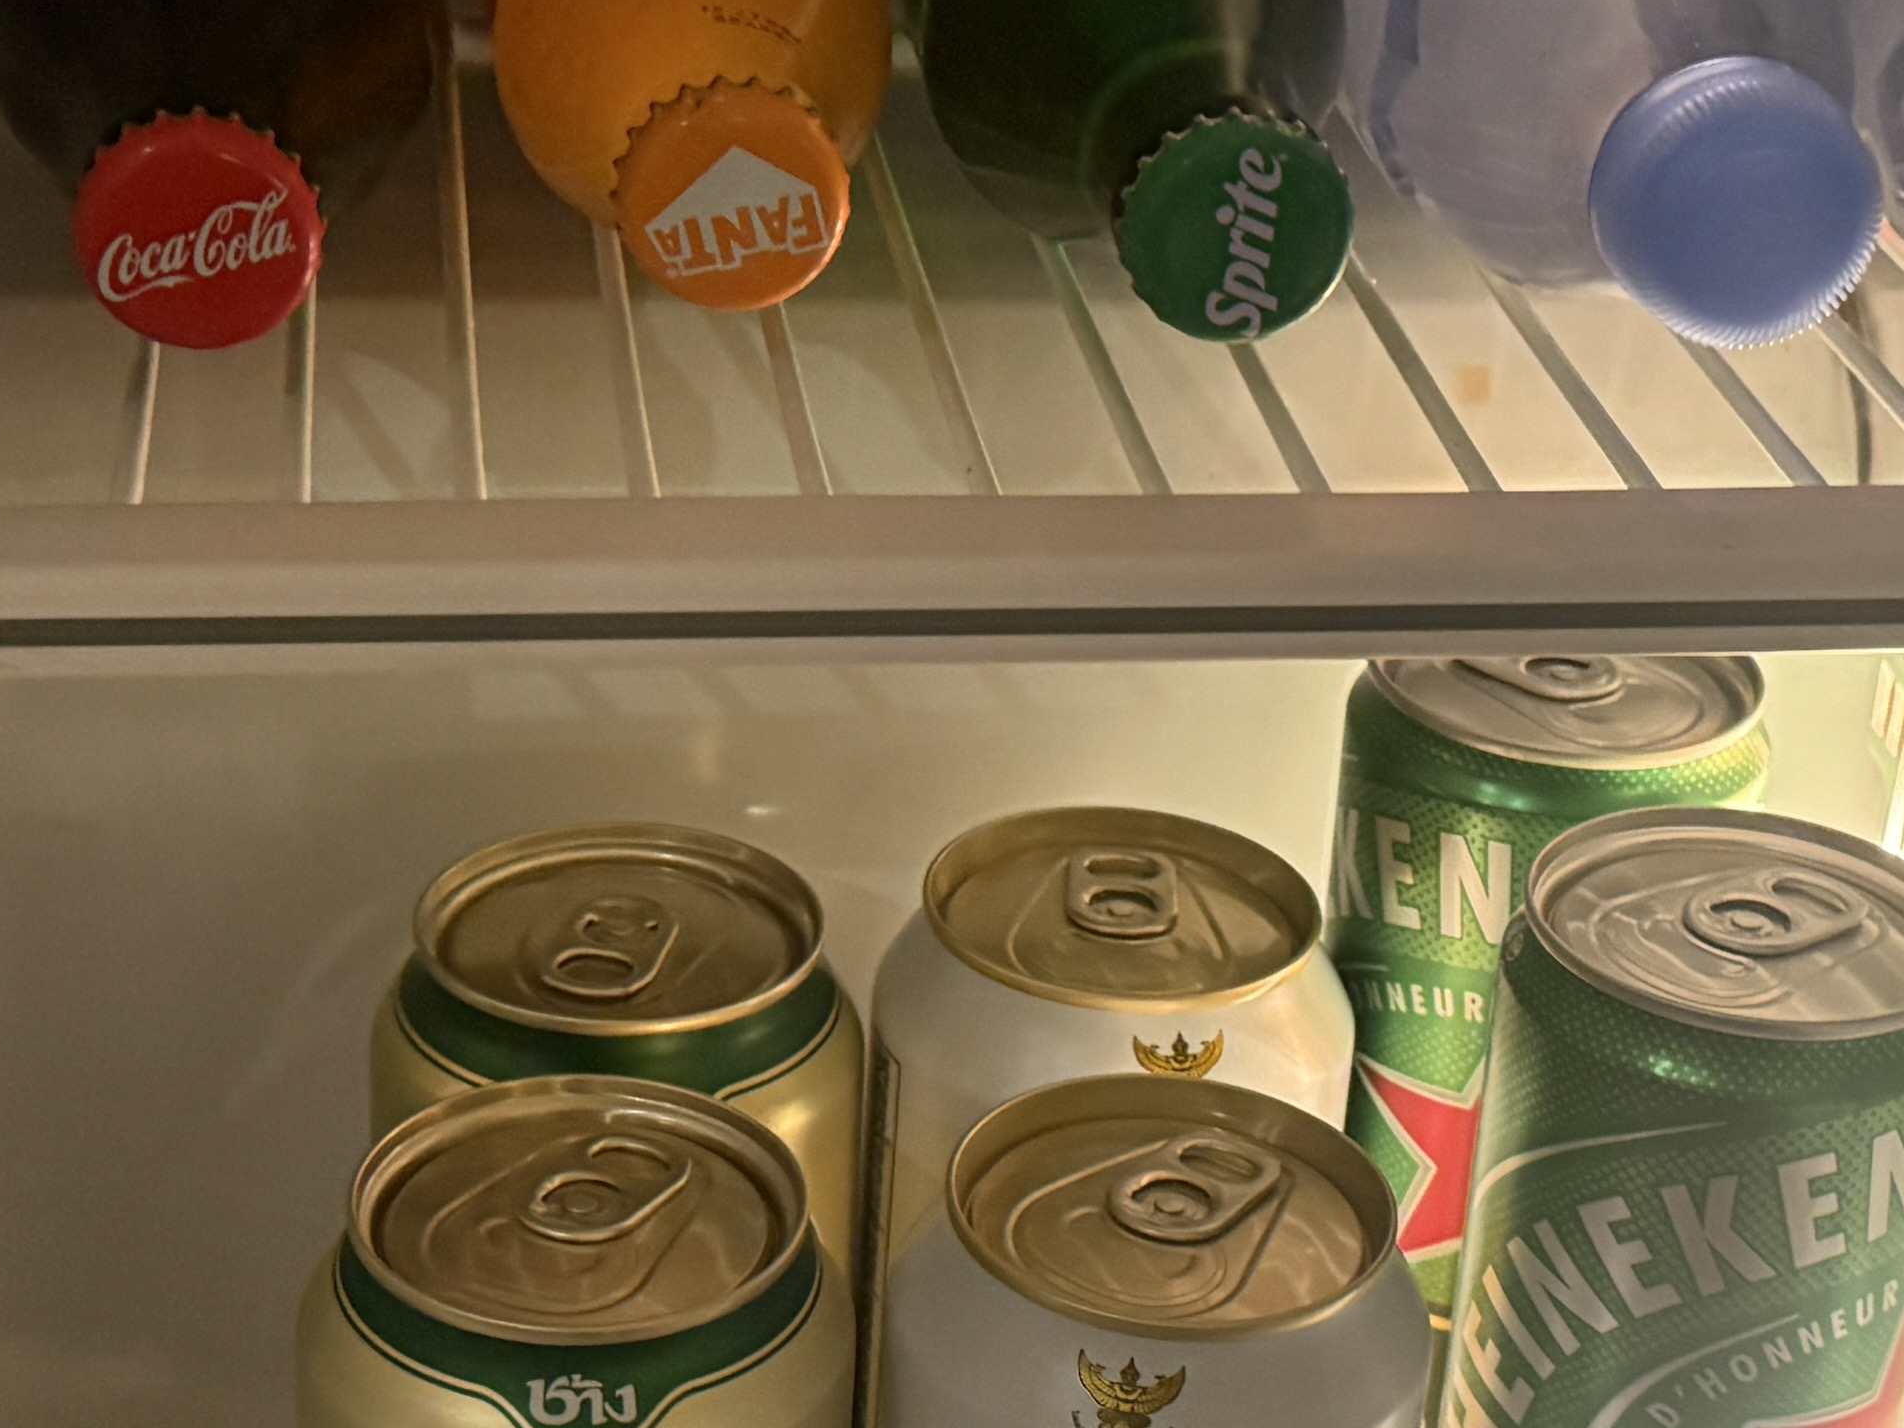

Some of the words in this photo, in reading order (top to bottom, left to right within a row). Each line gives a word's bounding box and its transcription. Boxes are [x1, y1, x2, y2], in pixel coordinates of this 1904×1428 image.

[98, 184, 294, 302] Coca-Cola
[648, 187, 830, 275] FANTA
[1205, 147, 1283, 337] Sprite
[1331, 808, 1512, 945] KEN
[527, 1373, 639, 1427] ช้าง
